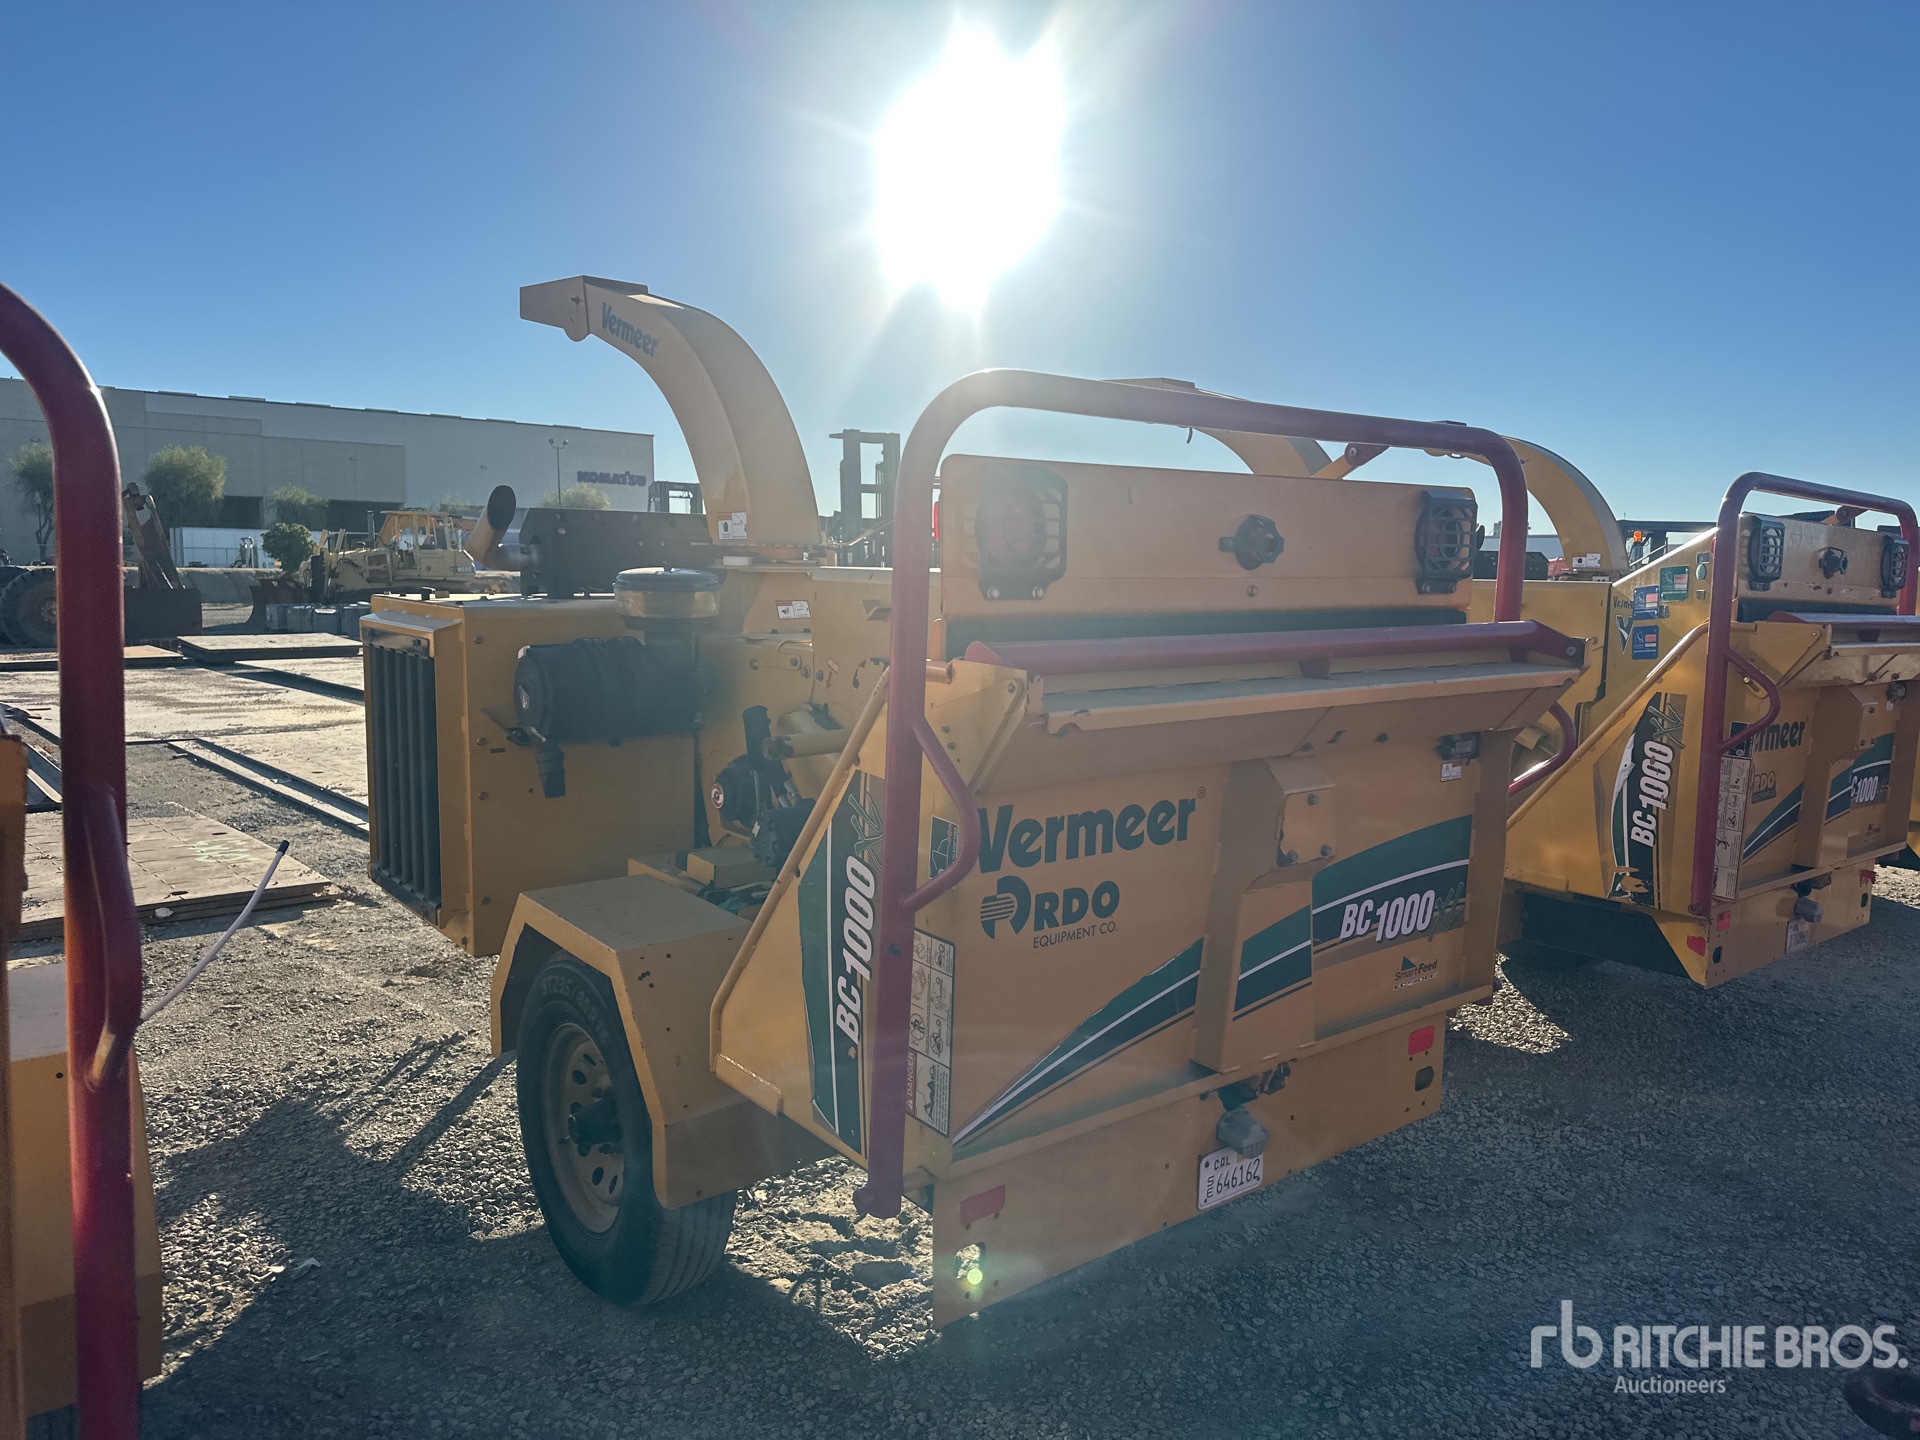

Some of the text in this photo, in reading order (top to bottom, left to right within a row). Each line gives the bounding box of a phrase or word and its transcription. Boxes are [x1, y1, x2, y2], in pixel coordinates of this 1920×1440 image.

[602, 301, 657, 357] Vermeer
[577, 471, 647, 486] KOMATSU
[978, 798, 1196, 874] Vermeer
[1034, 881, 1120, 931] RDO
[1033, 921, 1118, 949] EQUIPMENT CO.
[1213, 1156, 1231, 1170] CAL
[1216, 1158, 1261, 1194] 646162
